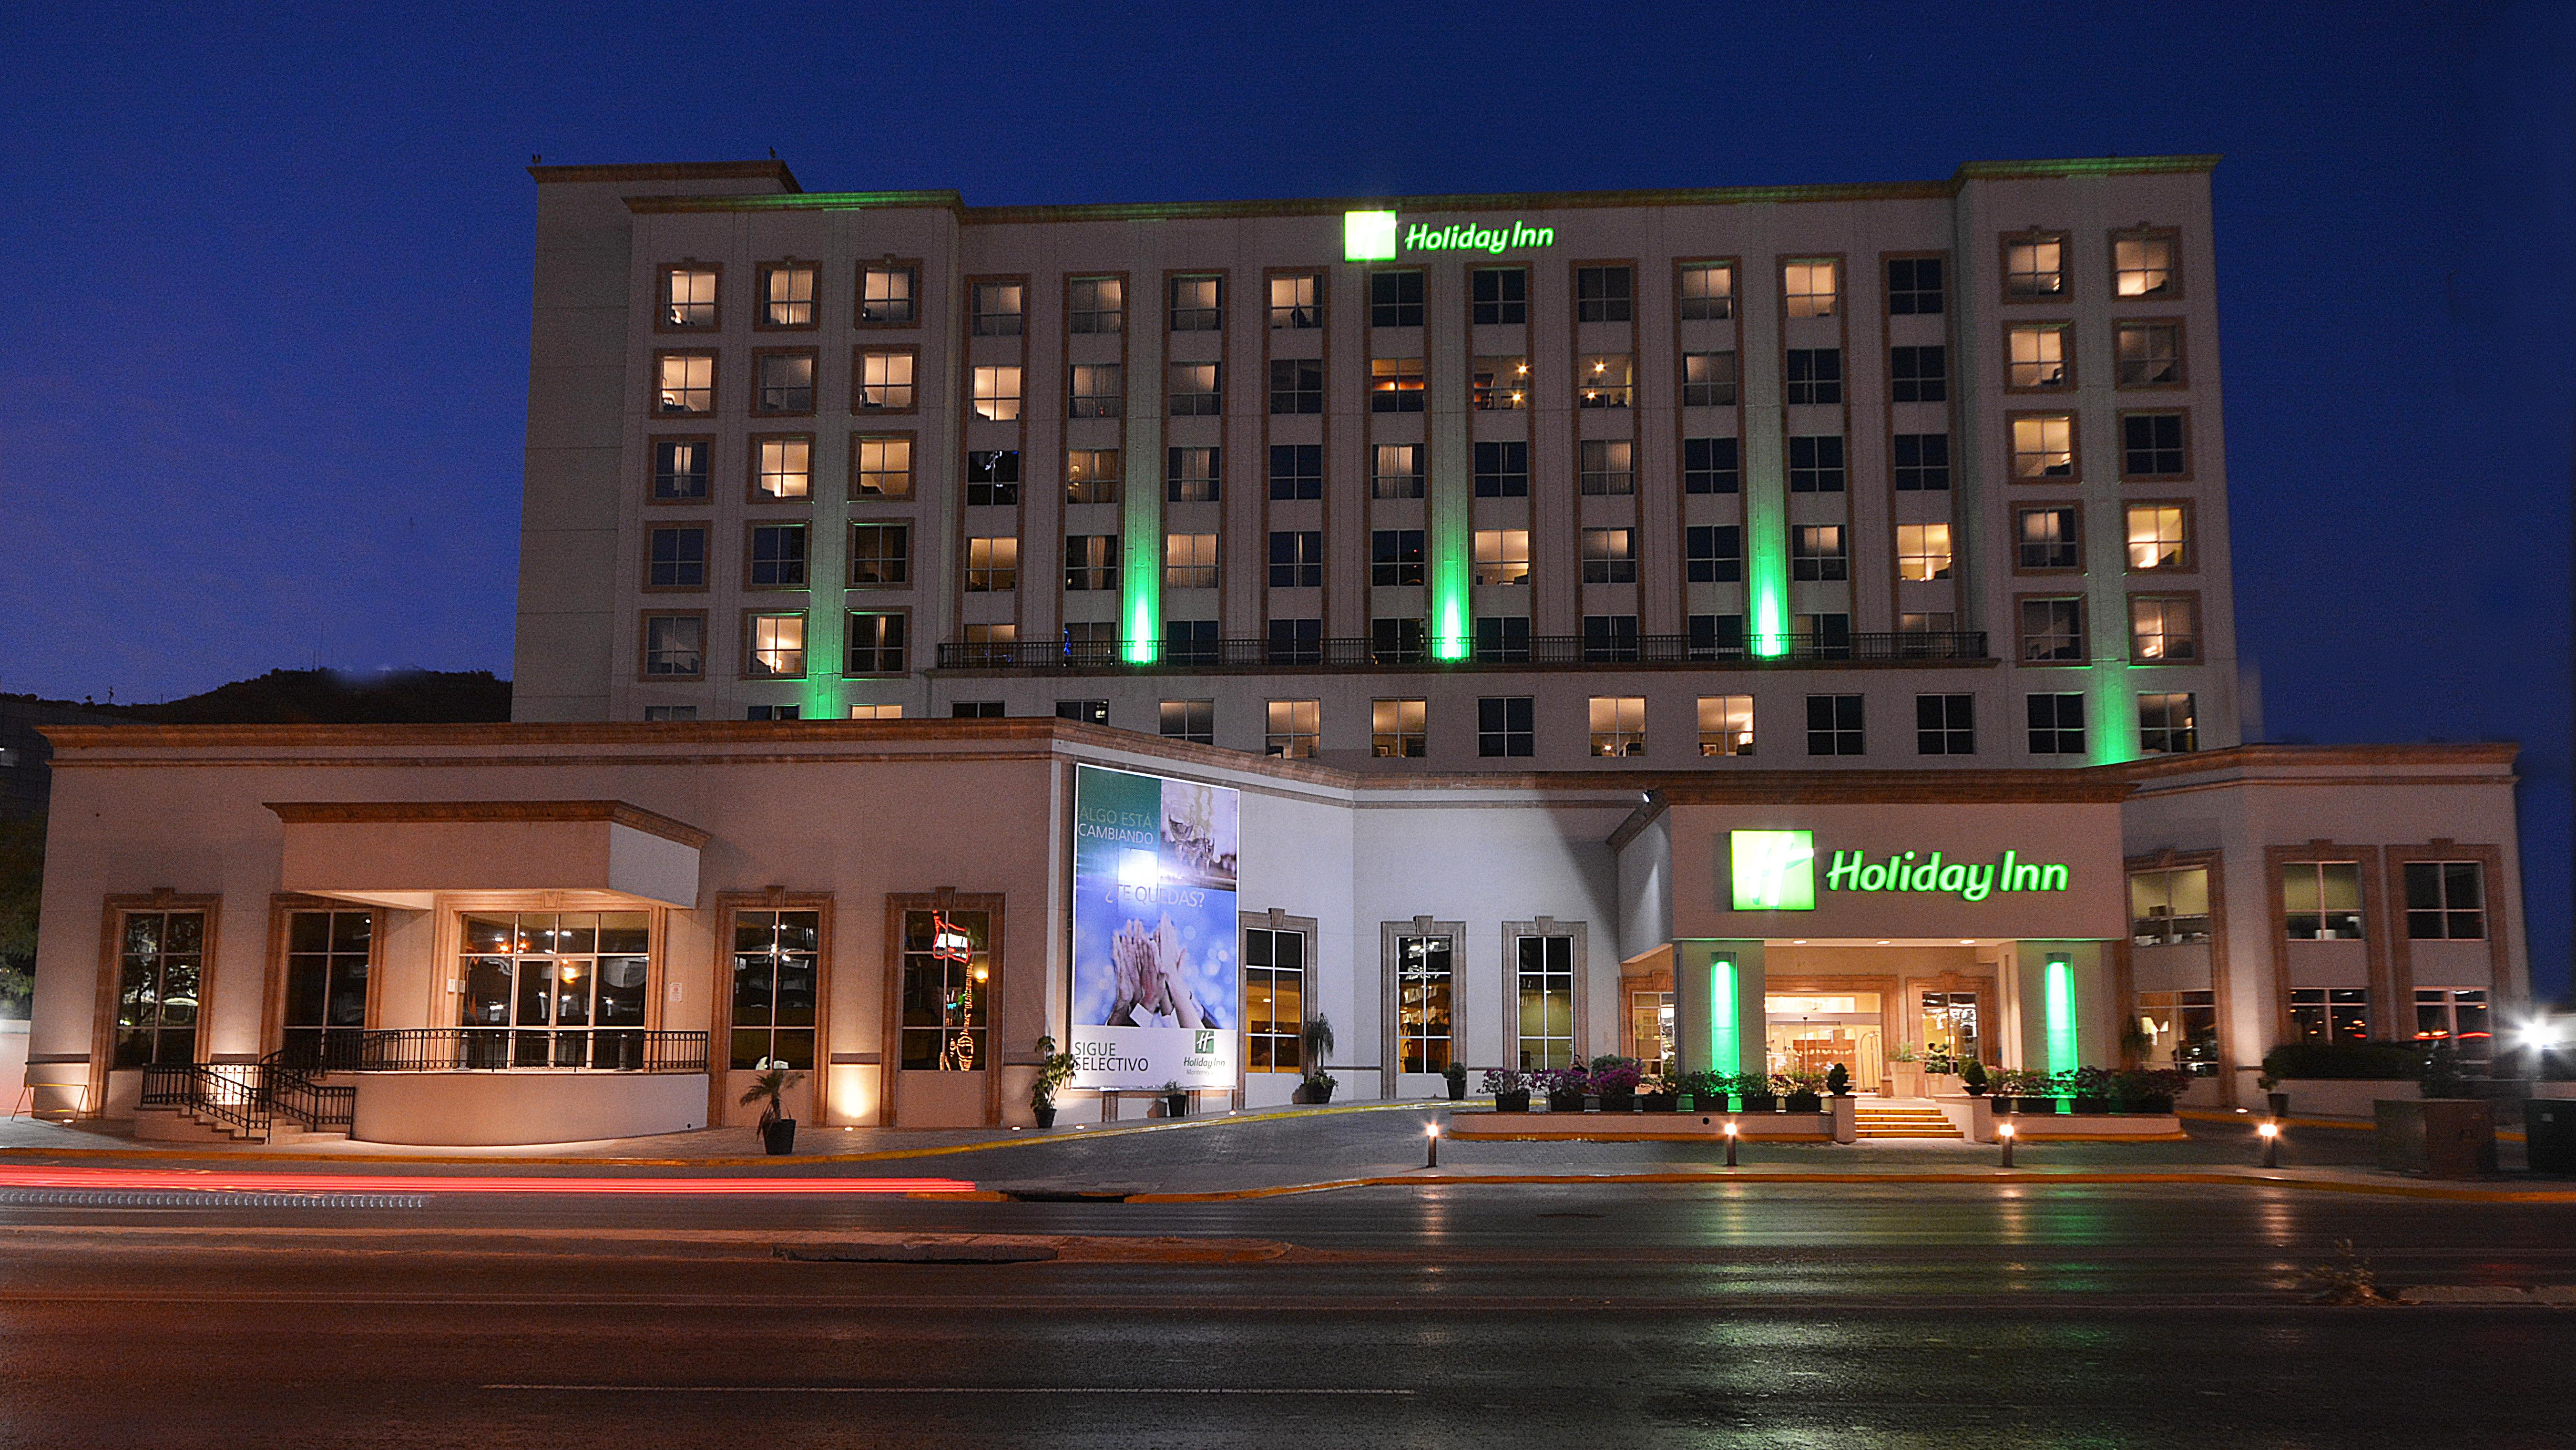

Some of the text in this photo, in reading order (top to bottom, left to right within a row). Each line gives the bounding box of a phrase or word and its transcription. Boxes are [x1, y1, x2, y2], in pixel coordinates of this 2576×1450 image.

[1405, 220, 1554, 255] Holiday Inn
[1079, 806, 1153, 829] ALGO ESTÁ
[1078, 823, 1153, 844] CAMBIANDO
[1826, 850, 2069, 901] Holiday Inn
[1105, 884, 1205, 907] ¿TE QUEDAS?
[1075, 1042, 1116, 1056] SIGUE
[1075, 1057, 1148, 1071] SELECTIVO
[1184, 1057, 1225, 1069] Holiday Inn
